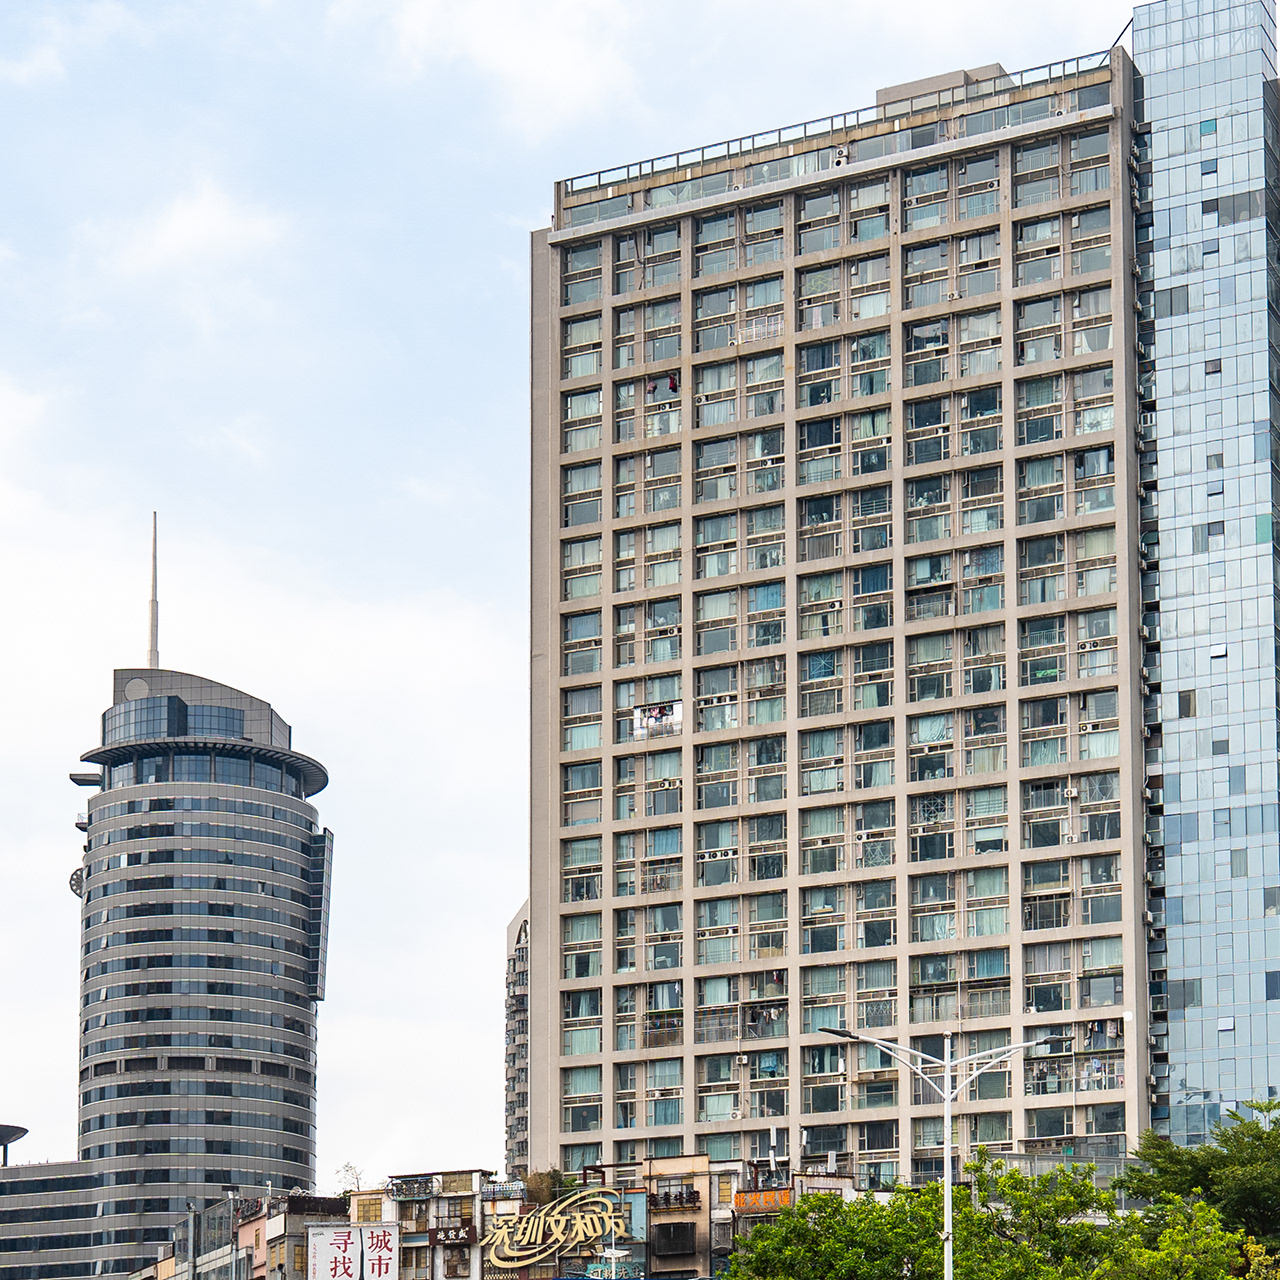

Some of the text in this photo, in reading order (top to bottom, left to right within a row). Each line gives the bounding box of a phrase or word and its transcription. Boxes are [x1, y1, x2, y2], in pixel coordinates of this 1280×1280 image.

[329, 1230, 354, 1279] 寻找
[590, 1265, 641, 1279] 河粉先生
